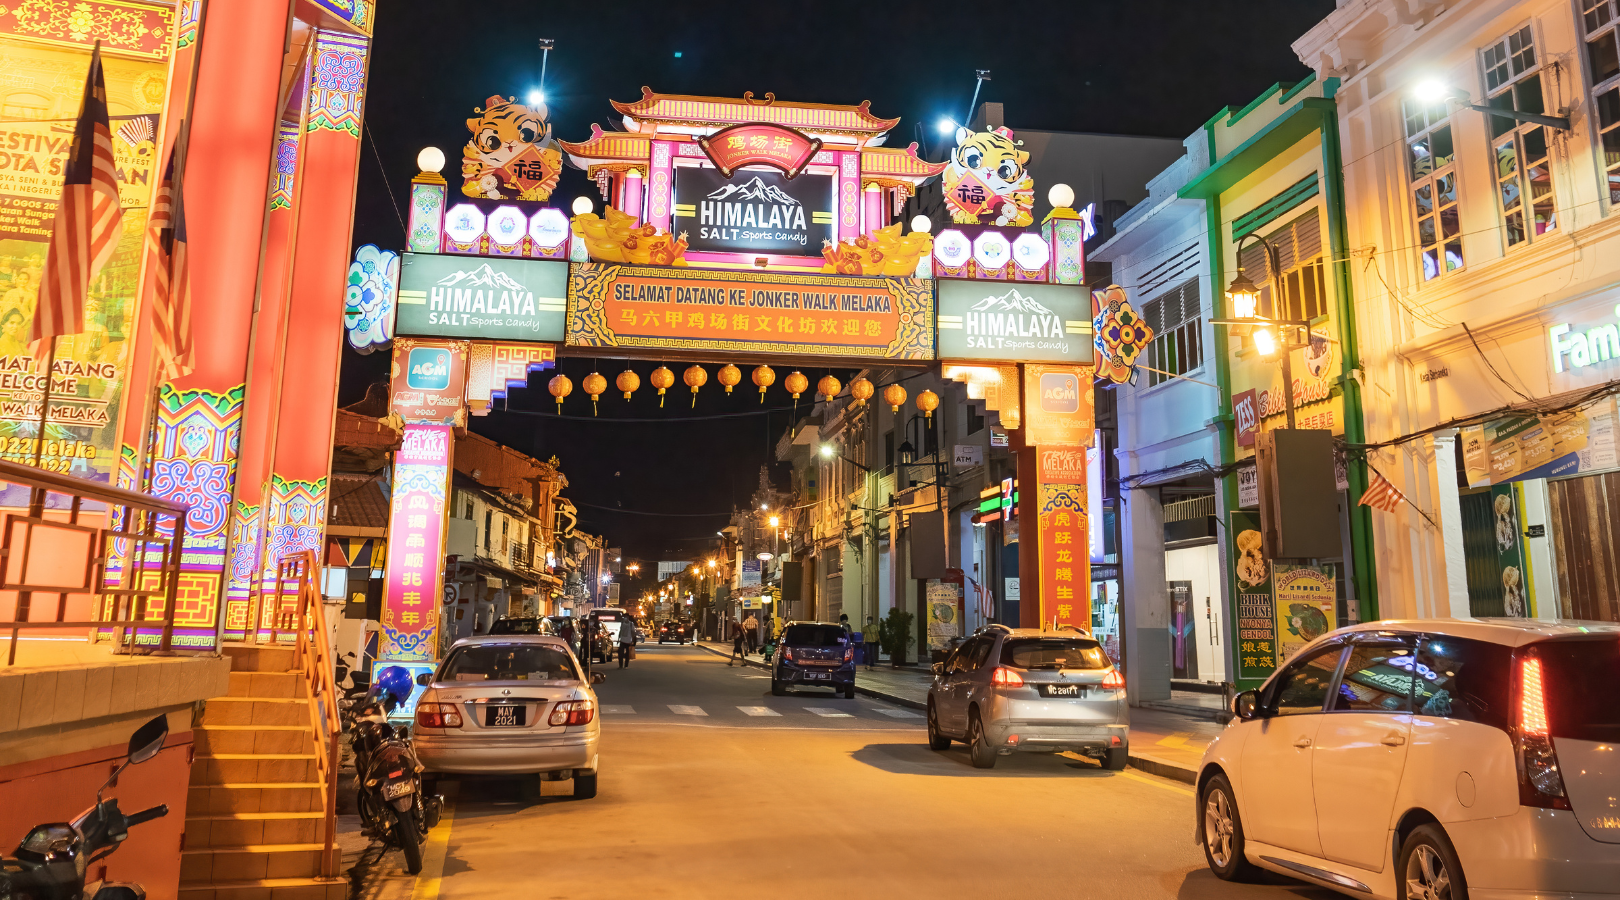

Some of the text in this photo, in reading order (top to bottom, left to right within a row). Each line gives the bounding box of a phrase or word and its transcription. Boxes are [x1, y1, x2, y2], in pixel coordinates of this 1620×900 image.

[727, 135, 793, 152] 鸡场街
[131, 158, 150, 166] FEST
[727, 150, 749, 160] JONKER
[769, 150, 792, 160] MELAKA
[513, 159, 543, 181] 福
[19, 176, 38, 184] SENI
[20, 186, 52, 195] NEGERI
[957, 184, 986, 205] 福
[12, 199, 42, 208] OGOS
[17, 217, 40, 226] Walk
[700, 200, 807, 231] HIMALAYA
[20, 226, 53, 238] Taming
[700, 227, 740, 241] SALT
[741, 231, 773, 243] Sports
[430, 286, 536, 316] HIMALAYA
[614, 283, 892, 314] SELAMAT DATANG KE JONKER WALK MELAKA
[429, 312, 470, 326] SALT
[469, 316, 503, 329] Sports
[619, 308, 882, 337] 马六甲鸡场街文化坊欢迎您
[966, 311, 1064, 339] HIMALAYA
[966, 336, 1004, 349] SALT
[1004, 340, 1036, 351] Sports
[36, 360, 116, 378] ATANG
[411, 362, 447, 376] AGM
[1044, 387, 1076, 400] AGM
[2, 402, 109, 422] WALK MELAKA
[401, 438, 446, 452] MELAKA
[1043, 459, 1082, 471] MELAKA
[1240, 470, 1257, 485] JOY
[400, 495, 429, 626] 风调雨顺兆丰年
[1053, 512, 1074, 630] 虎跃龙腾生紫
[1278, 570, 1297, 591] WORLD
[1297, 568, 1320, 581] LIZARD
[1240, 594, 1271, 606] BIBIK
[1240, 606, 1273, 618] HOUSE
[1240, 618, 1273, 629] NYONYA
[498, 706, 514, 718] MAY
[494, 716, 517, 726] 2021
[388, 787, 411, 798] 2049
